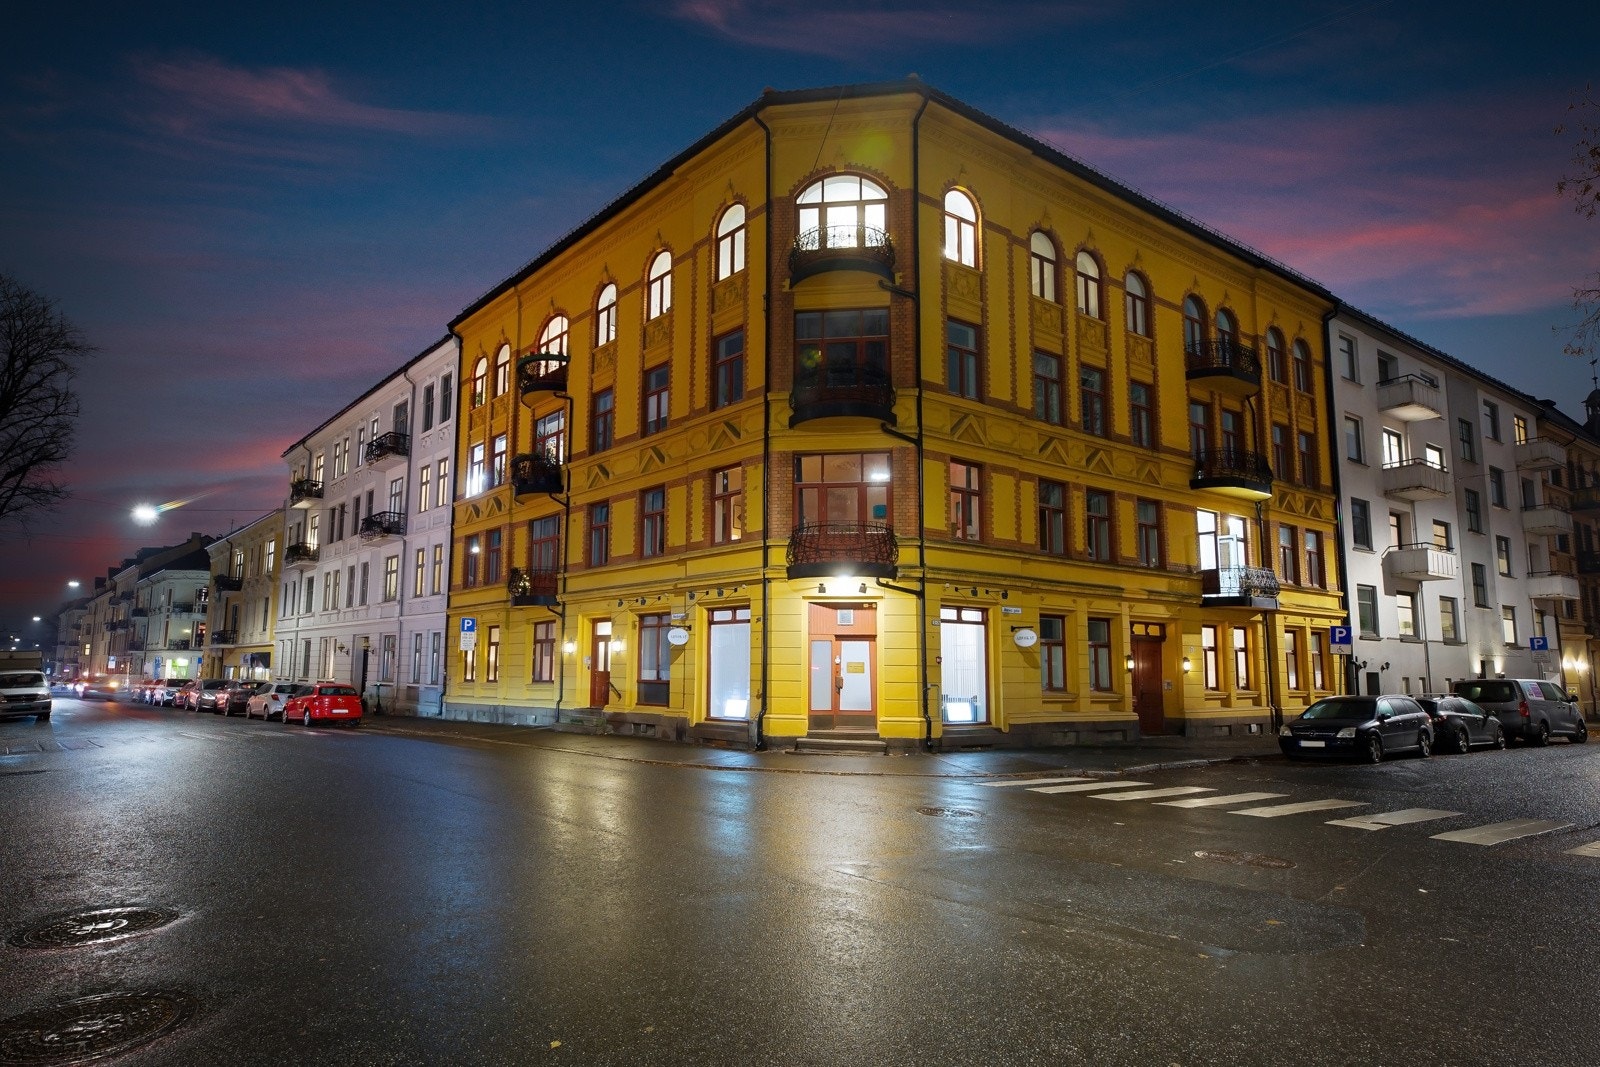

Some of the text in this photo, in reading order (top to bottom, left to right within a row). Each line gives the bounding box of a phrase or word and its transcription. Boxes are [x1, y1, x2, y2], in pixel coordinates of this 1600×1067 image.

[464, 619, 472, 631] P
[1335, 627, 1346, 642] P
[1533, 638, 1543, 649] P
